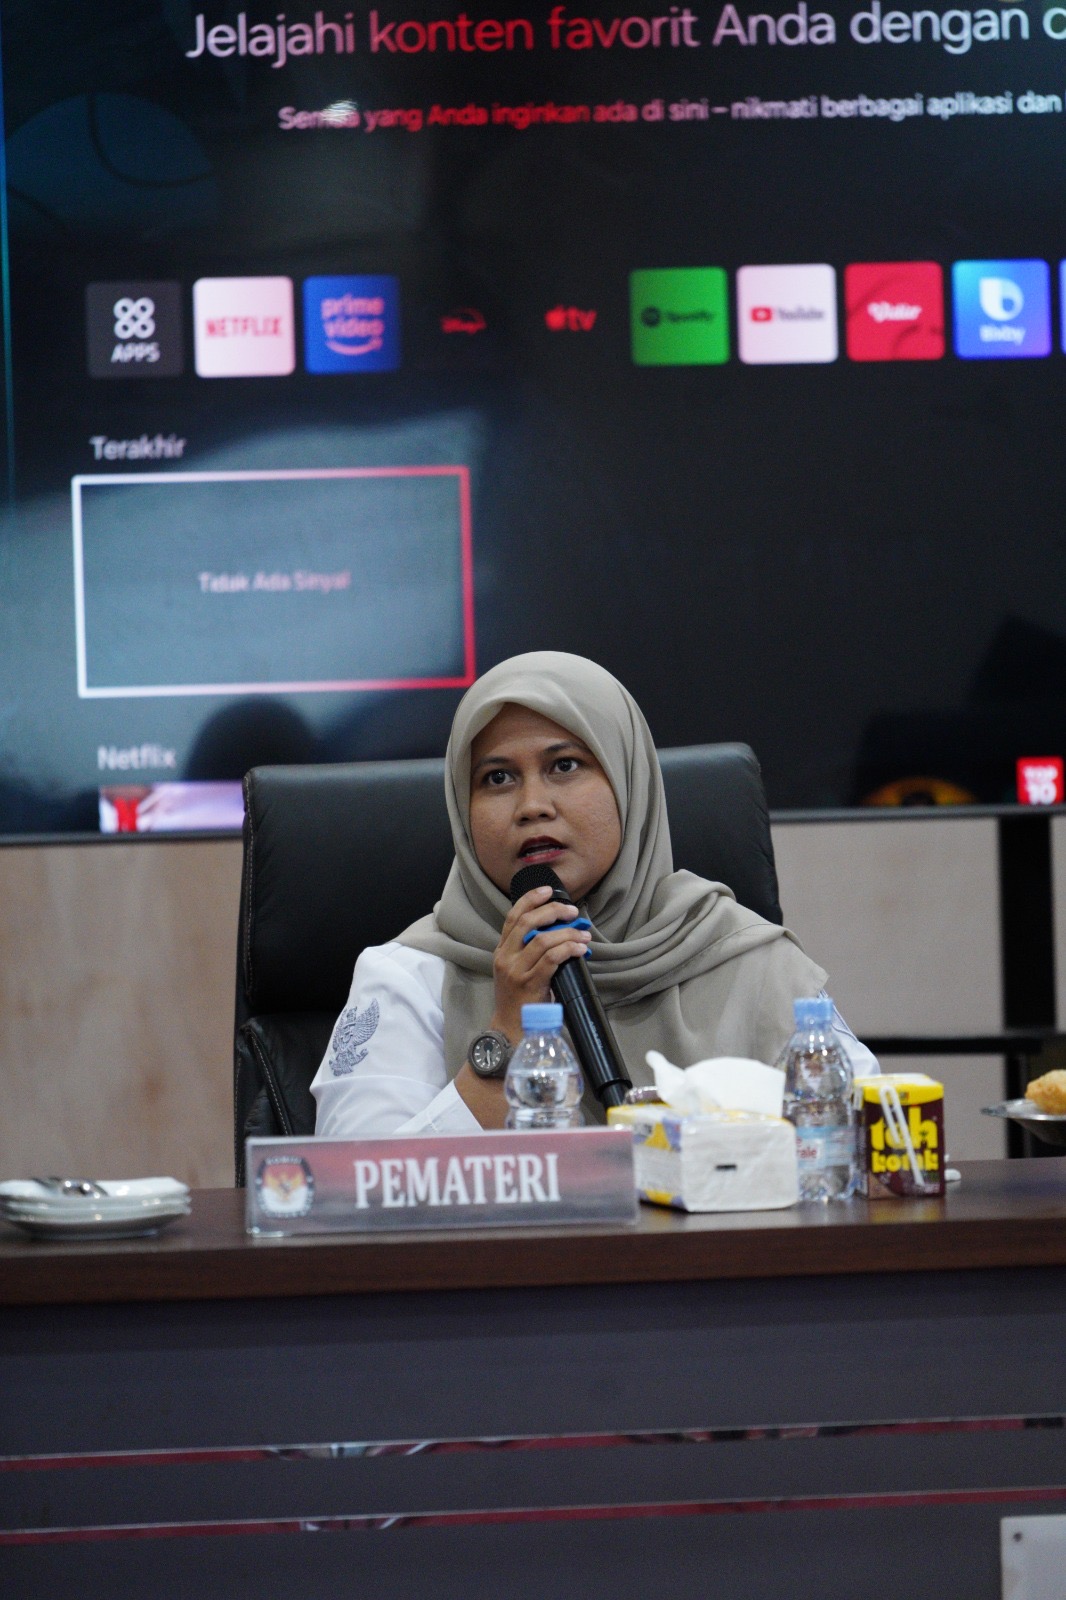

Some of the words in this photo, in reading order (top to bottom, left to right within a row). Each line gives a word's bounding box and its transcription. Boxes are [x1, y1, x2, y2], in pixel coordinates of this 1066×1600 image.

[185, 11, 355, 69] Jelajahi
[369, 10, 535, 54] konten
[546, 5, 700, 50] favorit
[711, 1, 837, 47] Anda
[849, 1, 1030, 55] dengan
[278, 106, 360, 130] Sema
[364, 109, 423, 132] yang
[427, 103, 488, 126] Anda
[492, 98, 591, 130] inginkan
[593, 99, 638, 122] ada
[641, 98, 664, 122] di
[669, 98, 709, 122] sini
[731, 96, 818, 120] nikmati
[820, 93, 924, 122] berbagai
[927, 90, 1013, 121] aplikasi
[1017, 90, 1063, 115] dan
[320, 293, 386, 319] prime
[205, 315, 283, 339] NETFLIX
[322, 314, 386, 339] video
[110, 342, 161, 363] APPS
[90, 434, 188, 461] Terakhir
[198, 571, 249, 593] Tidak
[252, 571, 292, 592] Ada
[294, 568, 352, 595] Sinyal
[97, 744, 178, 771] Netflix
[353, 1152, 562, 1210] PEMATERI
